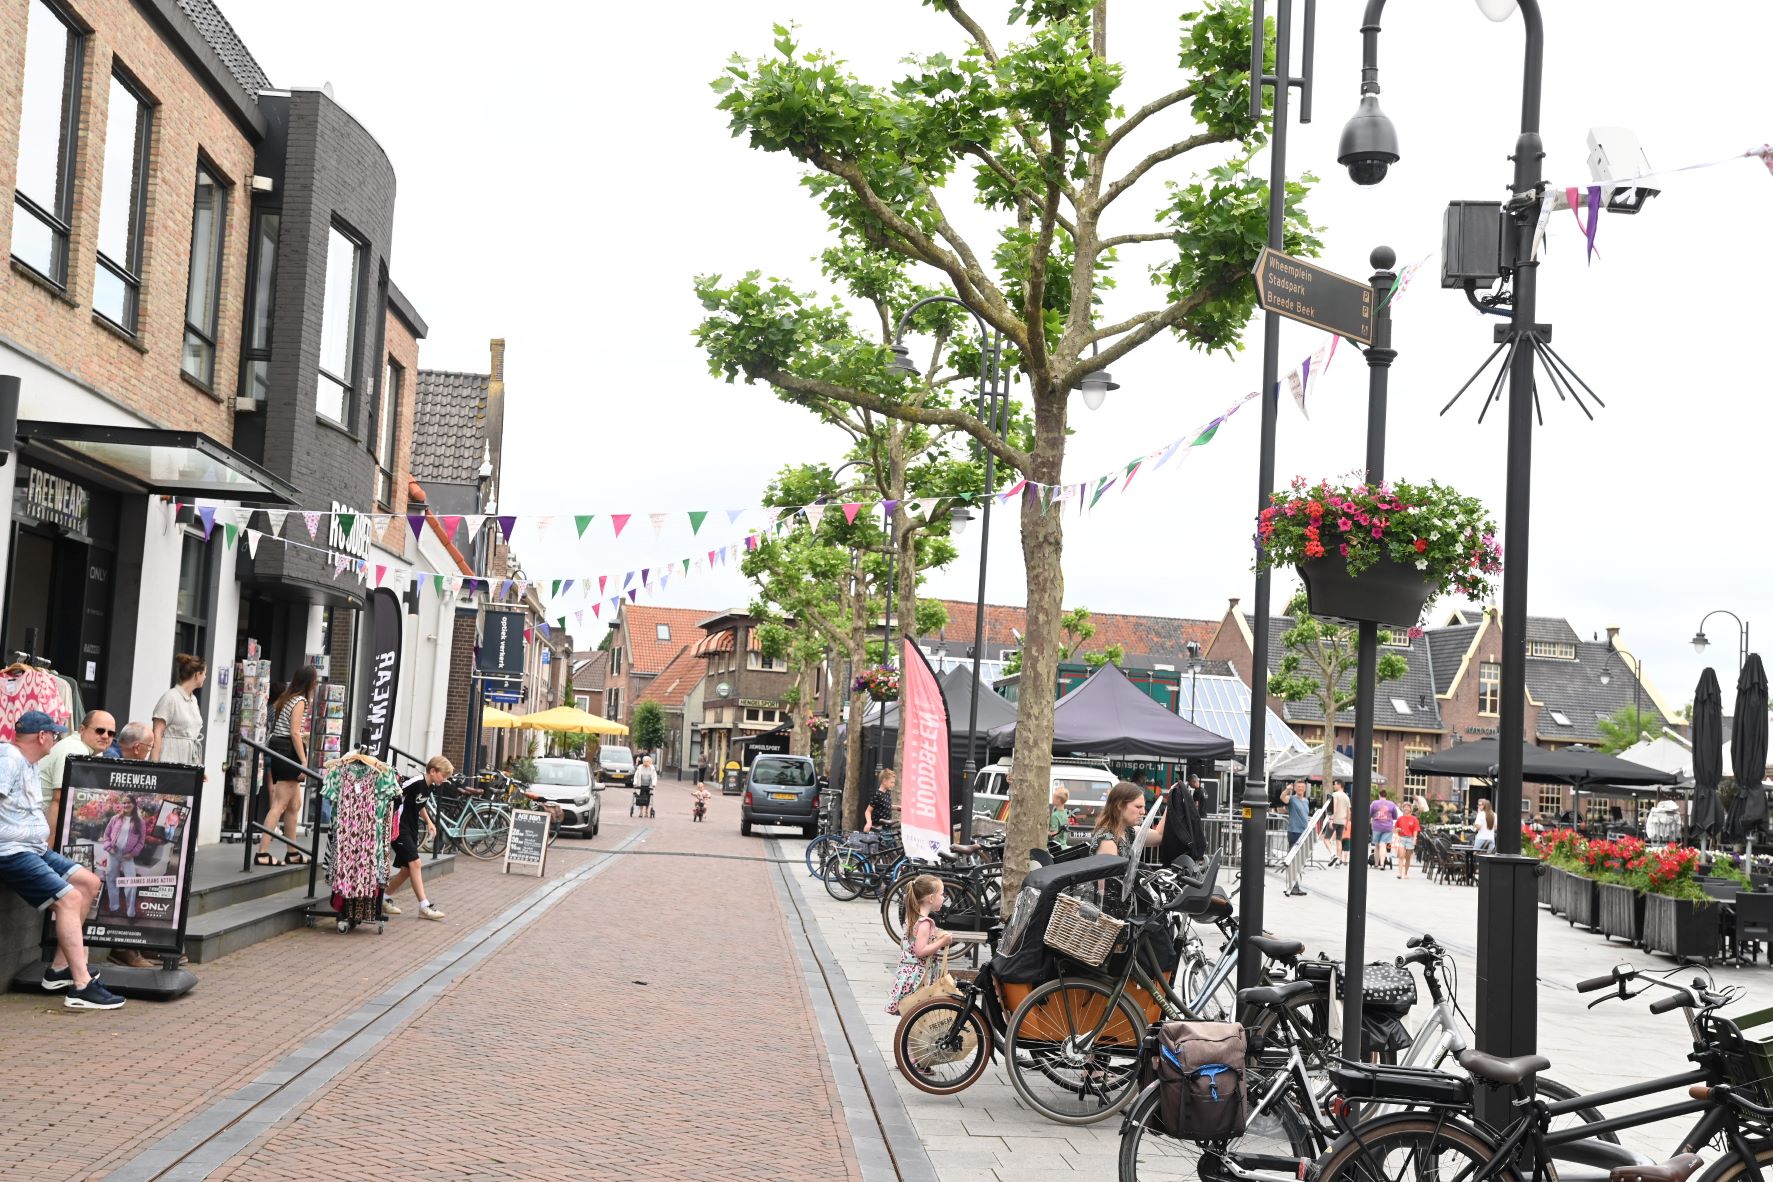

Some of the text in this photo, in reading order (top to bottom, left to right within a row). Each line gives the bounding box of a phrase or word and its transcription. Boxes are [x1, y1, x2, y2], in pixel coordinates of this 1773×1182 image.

[1268, 256, 1312, 283] Wheemplein
[1268, 272, 1305, 296] Stadspark
[1267, 291, 1315, 318] Breede Beek
[28, 467, 83, 519] FREEWEAR
[89, 566, 107, 581] ONLY
[500, 616, 508, 640] optiek
[498, 641, 506, 669] verkerk
[740, 699, 779, 707] HENGELSPORT
[748, 744, 780, 752] HENGELSPORT
[110, 772, 157, 786] FREEWEAR
[77, 792, 109, 802] ONLY
[140, 902, 170, 911] ONLY
